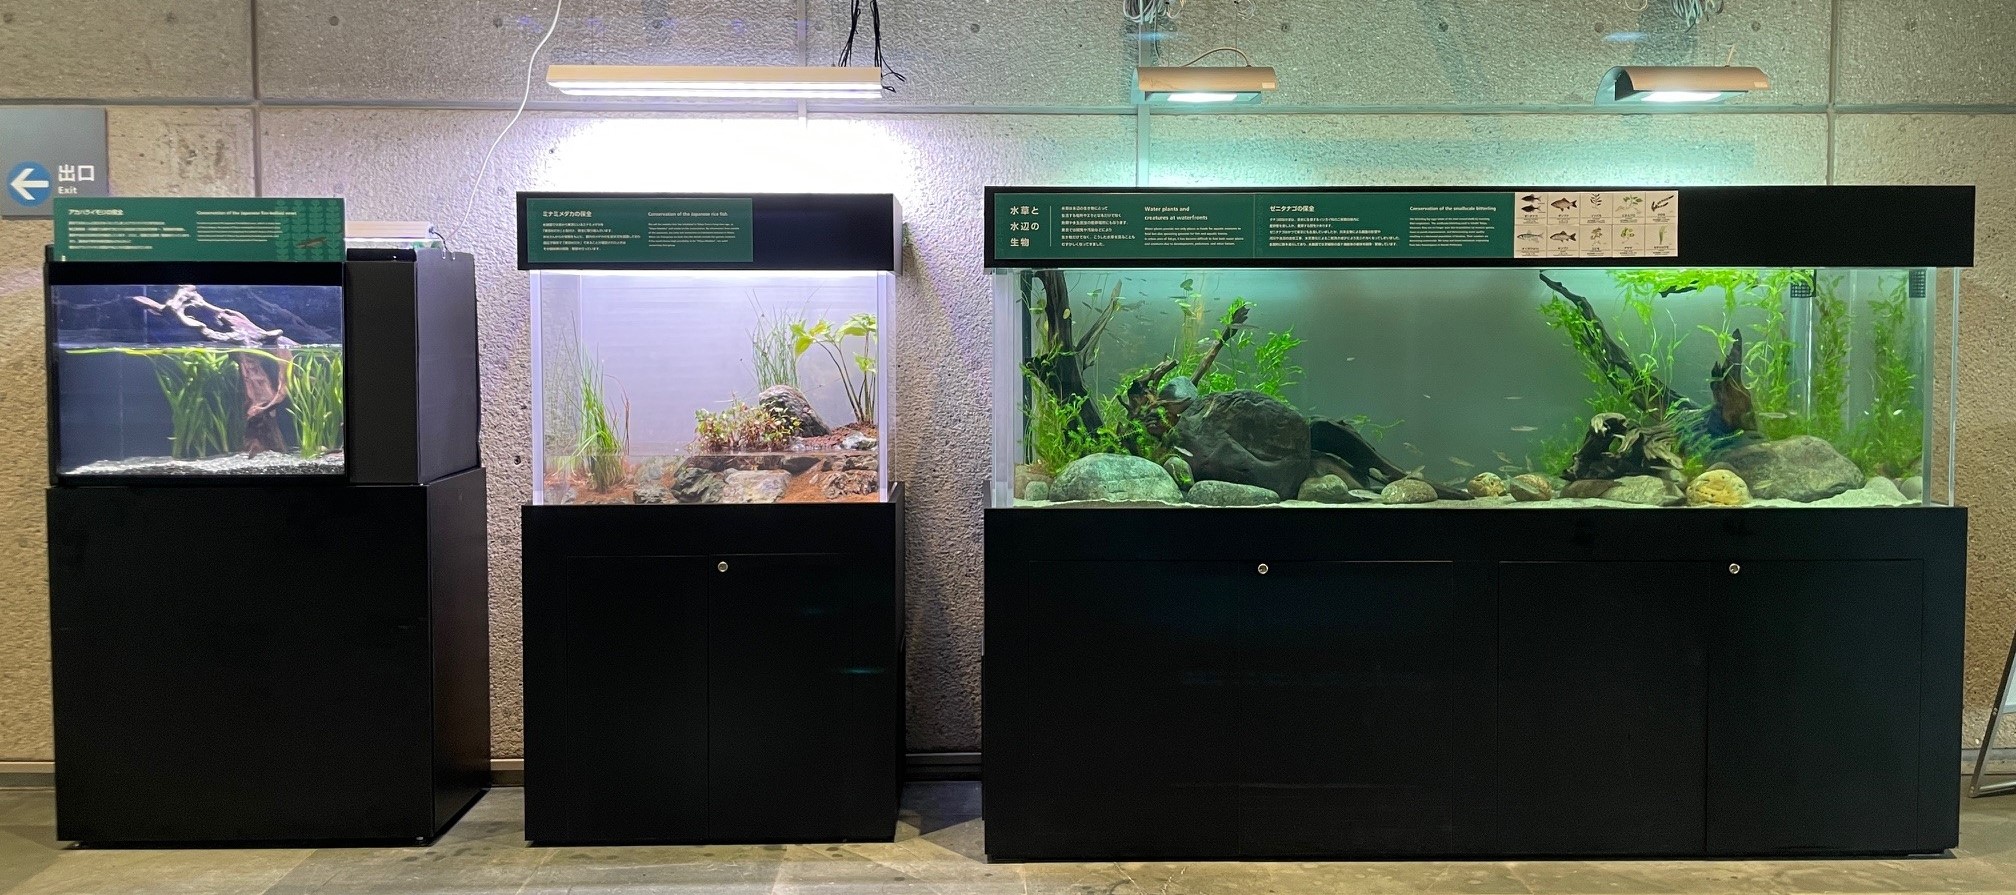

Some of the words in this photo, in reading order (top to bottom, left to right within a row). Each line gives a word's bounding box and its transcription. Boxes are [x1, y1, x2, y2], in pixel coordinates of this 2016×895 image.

[58, 164, 95, 182] 出口
[57, 186, 78, 195] Exit
[542, 210, 592, 218] ミナミメダカの保全
[1010, 205, 1040, 216] 水草と
[1010, 221, 1040, 231] 水辺の
[1010, 237, 1030, 247] 生物
